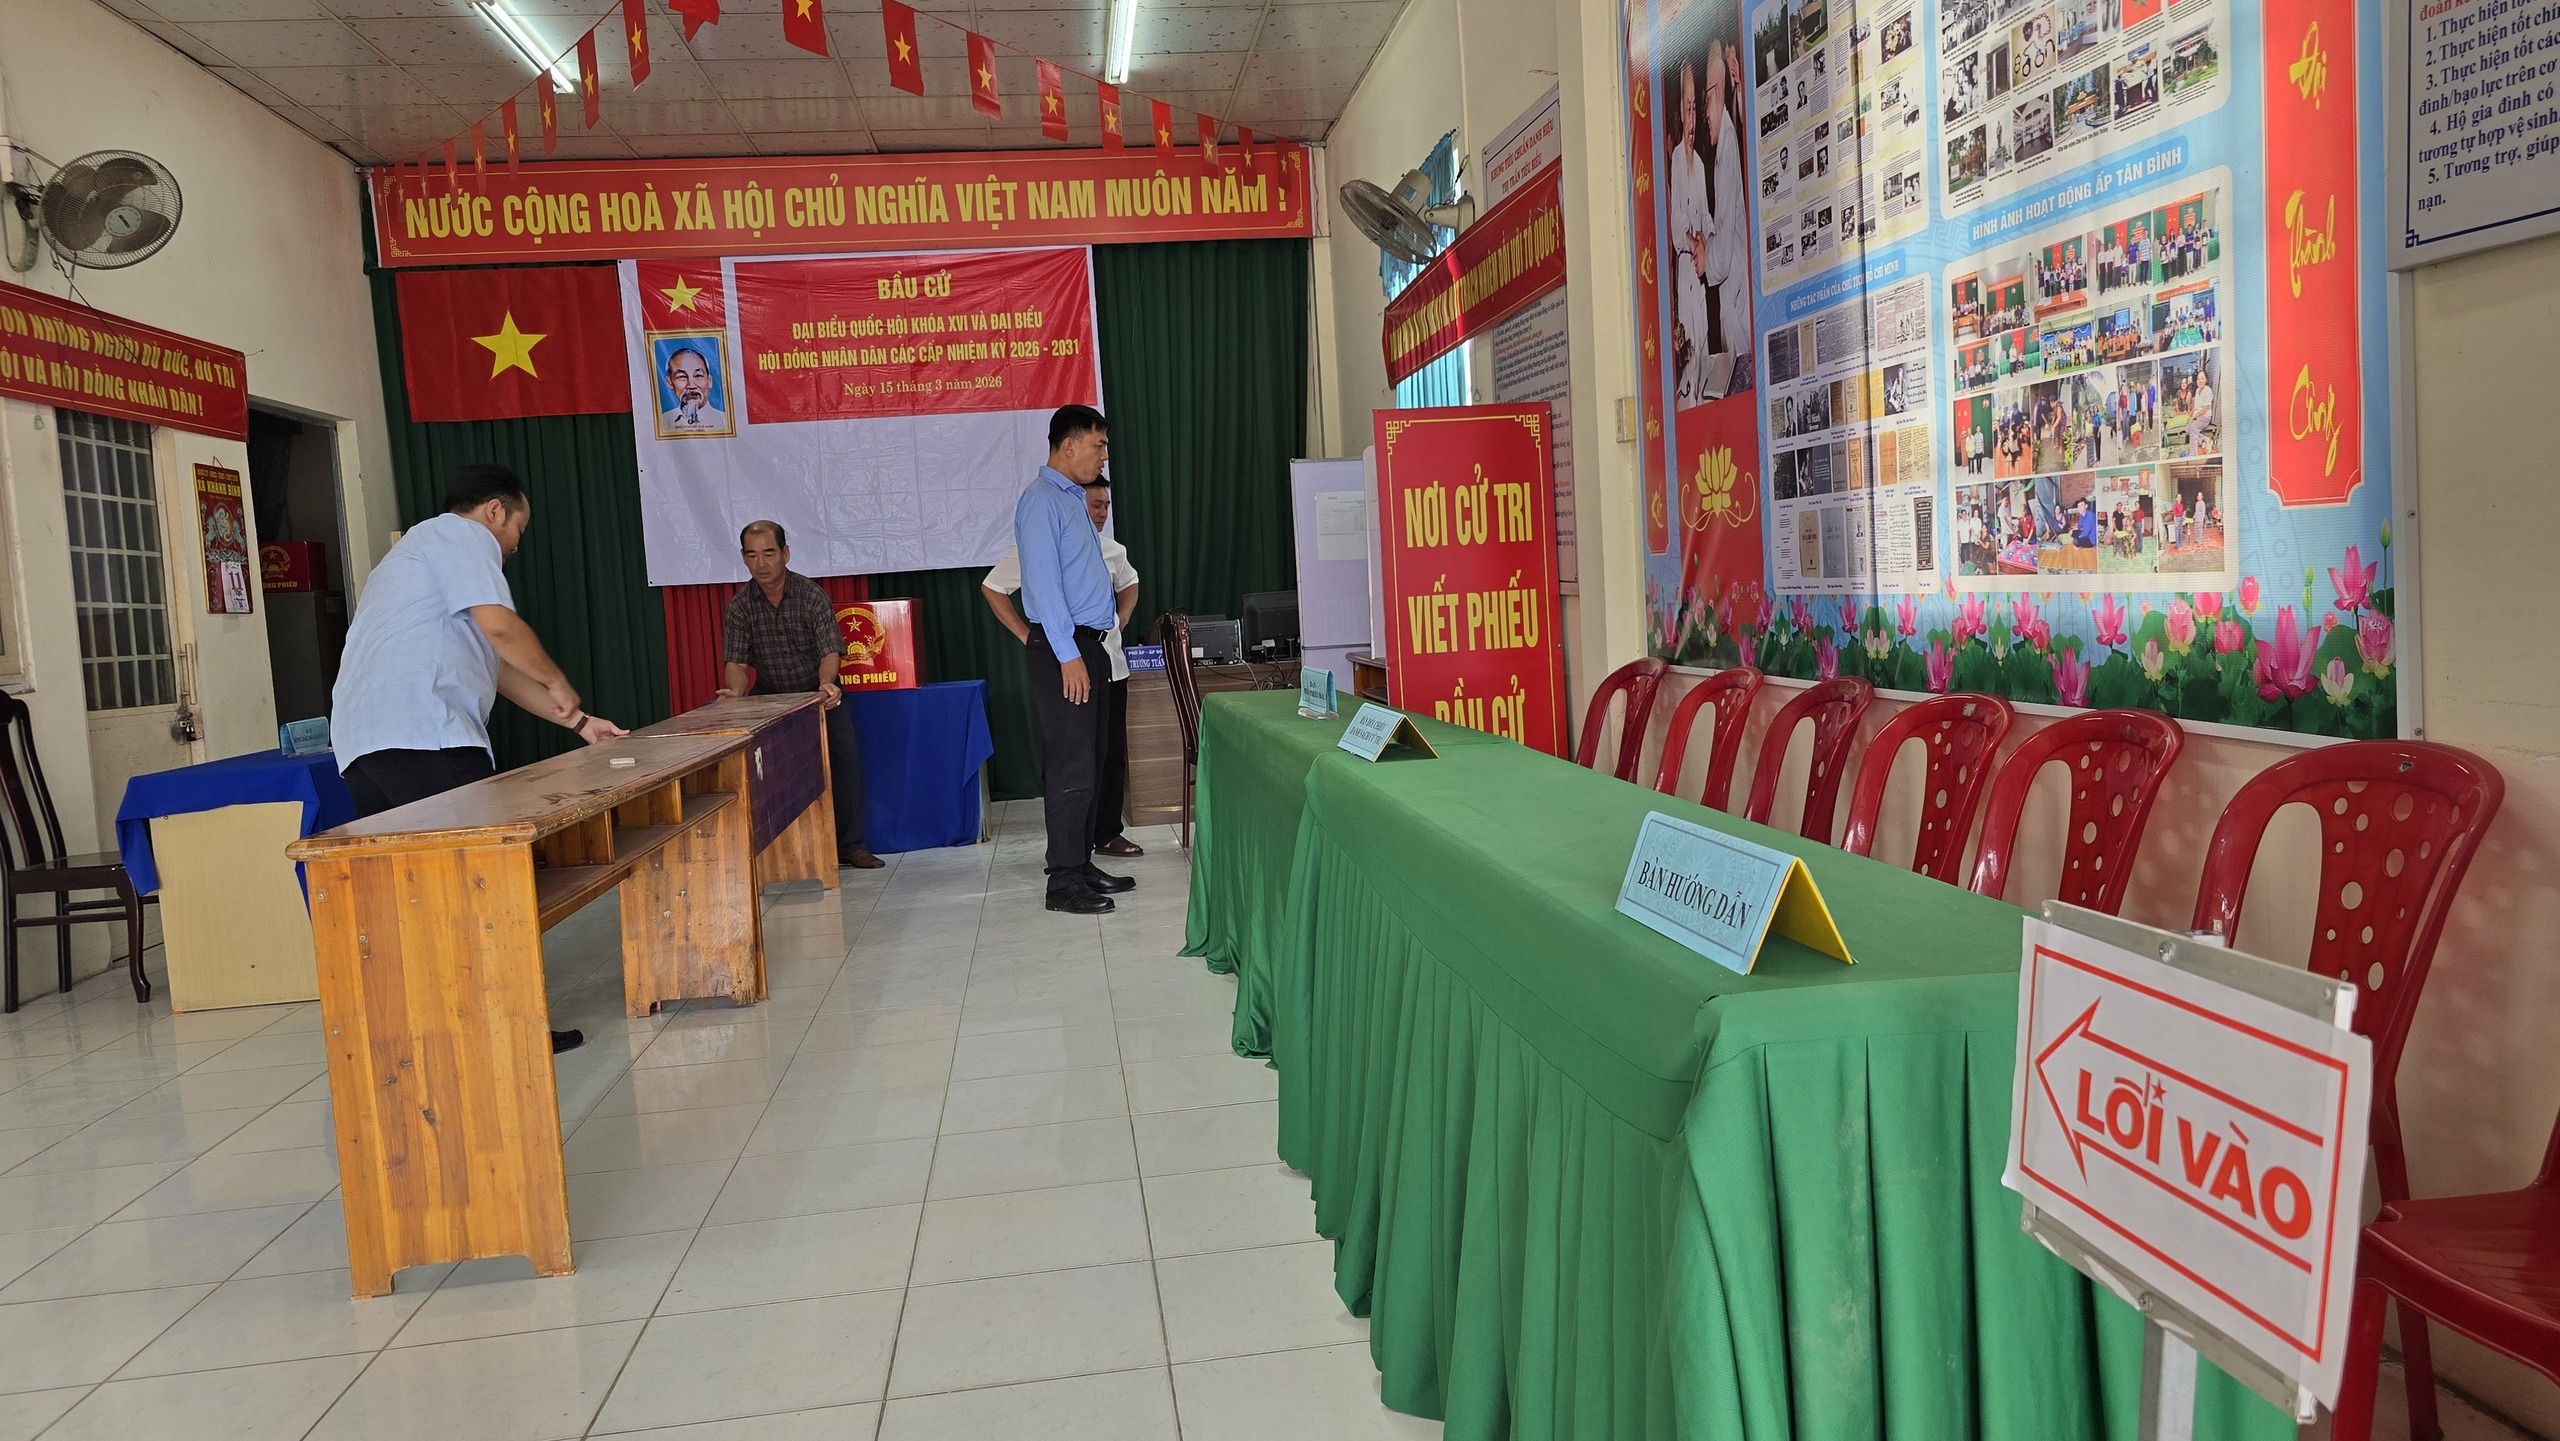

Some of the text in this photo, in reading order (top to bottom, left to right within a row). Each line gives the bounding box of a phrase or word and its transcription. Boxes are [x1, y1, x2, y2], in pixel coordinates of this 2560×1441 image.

[2426, 26, 2437, 43] 1.
[2439, 14, 2475, 37] Thực
[2478, 0, 2508, 22] hiện
[2426, 50, 2437, 67] 2.
[2439, 38, 2475, 61] Thực
[2478, 25, 2508, 48] hiện
[2511, 10, 2532, 35] tốt
[2419, 58, 2557, 116] đình/bạo lực trên cơ
[2426, 74, 2438, 91] 3.
[2440, 62, 2476, 85] Thực
[2480, 49, 2509, 72] hiện
[2514, 34, 2534, 59] tốt
[2430, 82, 2553, 136] 4. Hộ gia đình có
[2419, 141, 2458, 163] tương
[2460, 135, 2476, 153] tự
[2478, 126, 2505, 147] hợp
[2508, 116, 2524, 138] vệ
[2428, 134, 2560, 184] 5. Tương trợ, giúp
[405, 187, 494, 239] NƯỚC
[503, 185, 591, 245] CỘNG
[600, 182, 665, 234] HOÀ
[671, 182, 715, 232] XÃ
[724, 179, 776, 238] HỘI
[785, 173, 846, 228] CHỦ
[855, 176, 949, 225] NGHĨA
[955, 173, 1018, 231] VIỆT
[1028, 179, 1097, 220] NAM
[1105, 168, 1192, 218] MUÔN
[1200, 167, 1268, 215] NĂM
[1972, 146, 2182, 241] HÌNH ẢNH HOẠT ĐỘNG ẤP TÂN BÌNH
[2418, 193, 2446, 212] nạn.
[877, 269, 952, 300] BẦU CỬ
[0, 305, 236, 389] ỌN NHỮNG NGƯỜI ĐỦ ĐỨC, ĐỦ TÀI
[792, 304, 1043, 344] ĐẠI BIỂU QUỐC HỘI KHÓA XVI VÀ ĐẠI BIỂU
[22, 353, 48, 386] VÀ
[50, 360, 79, 392] HỘI
[82, 363, 126, 401] ĐỒNG
[127, 379, 168, 410] NHÂN
[169, 386, 197, 416] DÂN
[758, 349, 781, 374] HỘI
[783, 346, 819, 370] ĐỒNG
[821, 346, 857, 367] NHÂN
[861, 345, 888, 366] DÂN
[890, 343, 916, 364] CÁC
[918, 339, 944, 363] CẤP
[947, 340, 988, 364] NHIỆM
[991, 339, 1007, 359] KỲ
[1010, 340, 1040, 359] 2026
[1051, 339, 1080, 357] 2031
[843, 376, 1003, 398] Ngày 15 tháng 3 năm 2026
[1404, 480, 1449, 548] NƠI
[1454, 463, 1489, 547] CỬ
[1493, 481, 1533, 542] TRI
[228, 570, 242, 591] 11
[1407, 569, 1539, 655] VIẾT PHIẾU
[862, 669, 897, 684] PHIẾU
[1491, 674, 1526, 745] CỬ
[1637, 856, 1752, 931] BÀN HƯỚNG DẪN
[2076, 1067, 2312, 1240] LỐI VÀO
